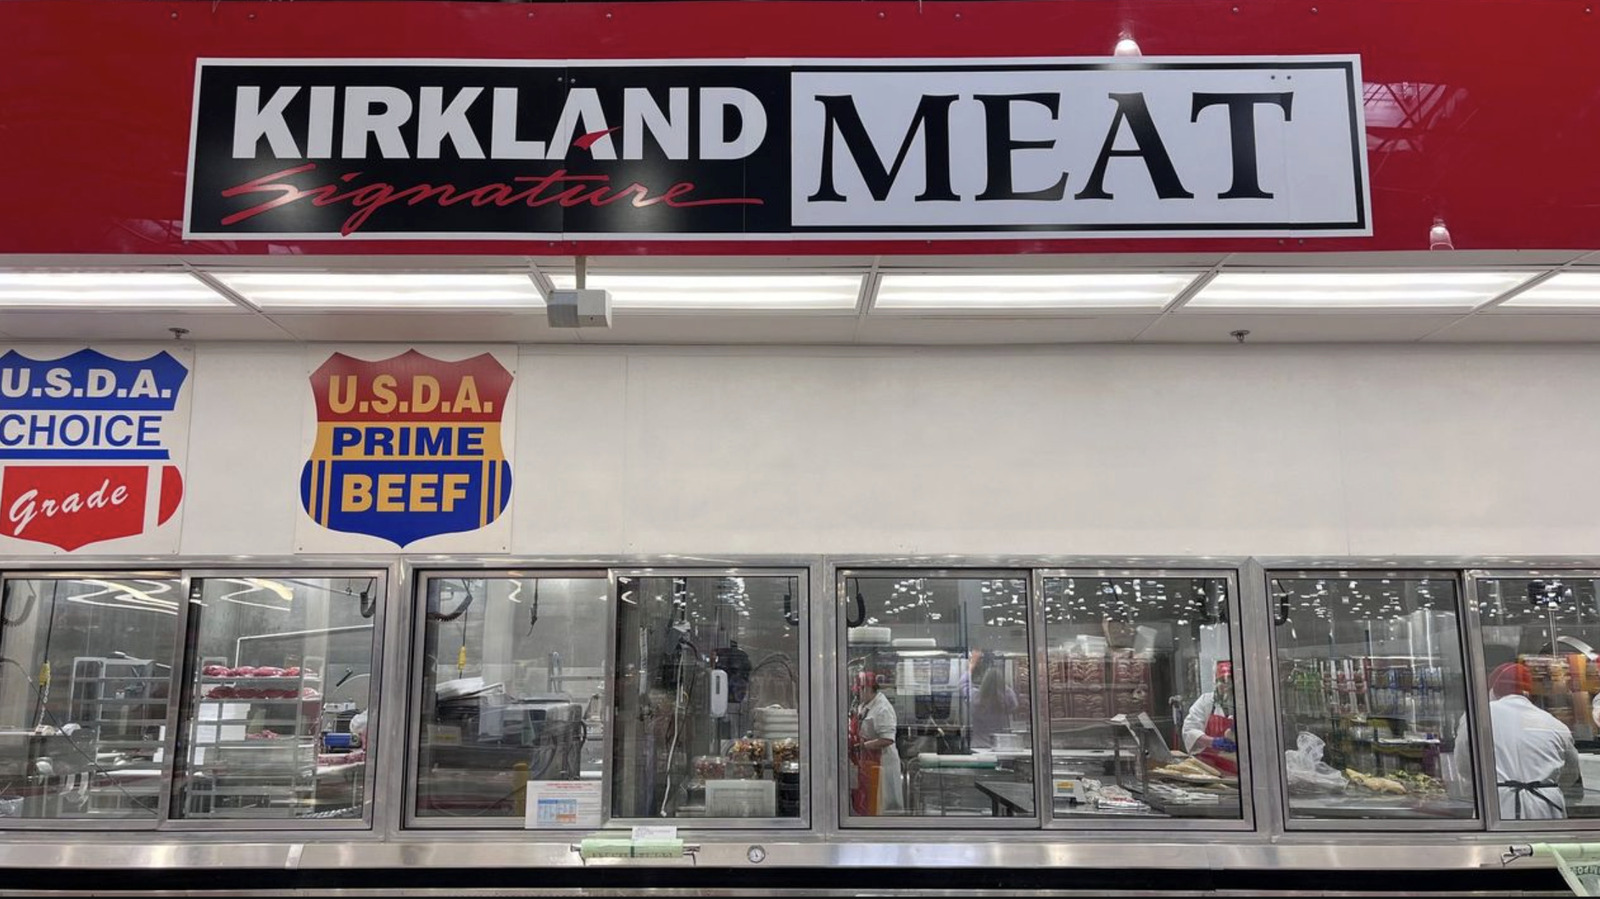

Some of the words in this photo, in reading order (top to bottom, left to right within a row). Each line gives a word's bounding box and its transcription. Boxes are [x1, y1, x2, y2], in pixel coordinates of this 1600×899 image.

[232, 85, 768, 161] KIRKLAND
[807, 91, 1294, 203] MEAT
[221, 163, 764, 237] Signature
[1, 368, 172, 398] U.S.D.A.
[328, 375, 494, 414] U.S.D.A.
[0, 414, 162, 447] CHOICE
[332, 427, 485, 456] PRIME
[8, 479, 129, 536] Grade
[340, 474, 470, 513] BEEF
